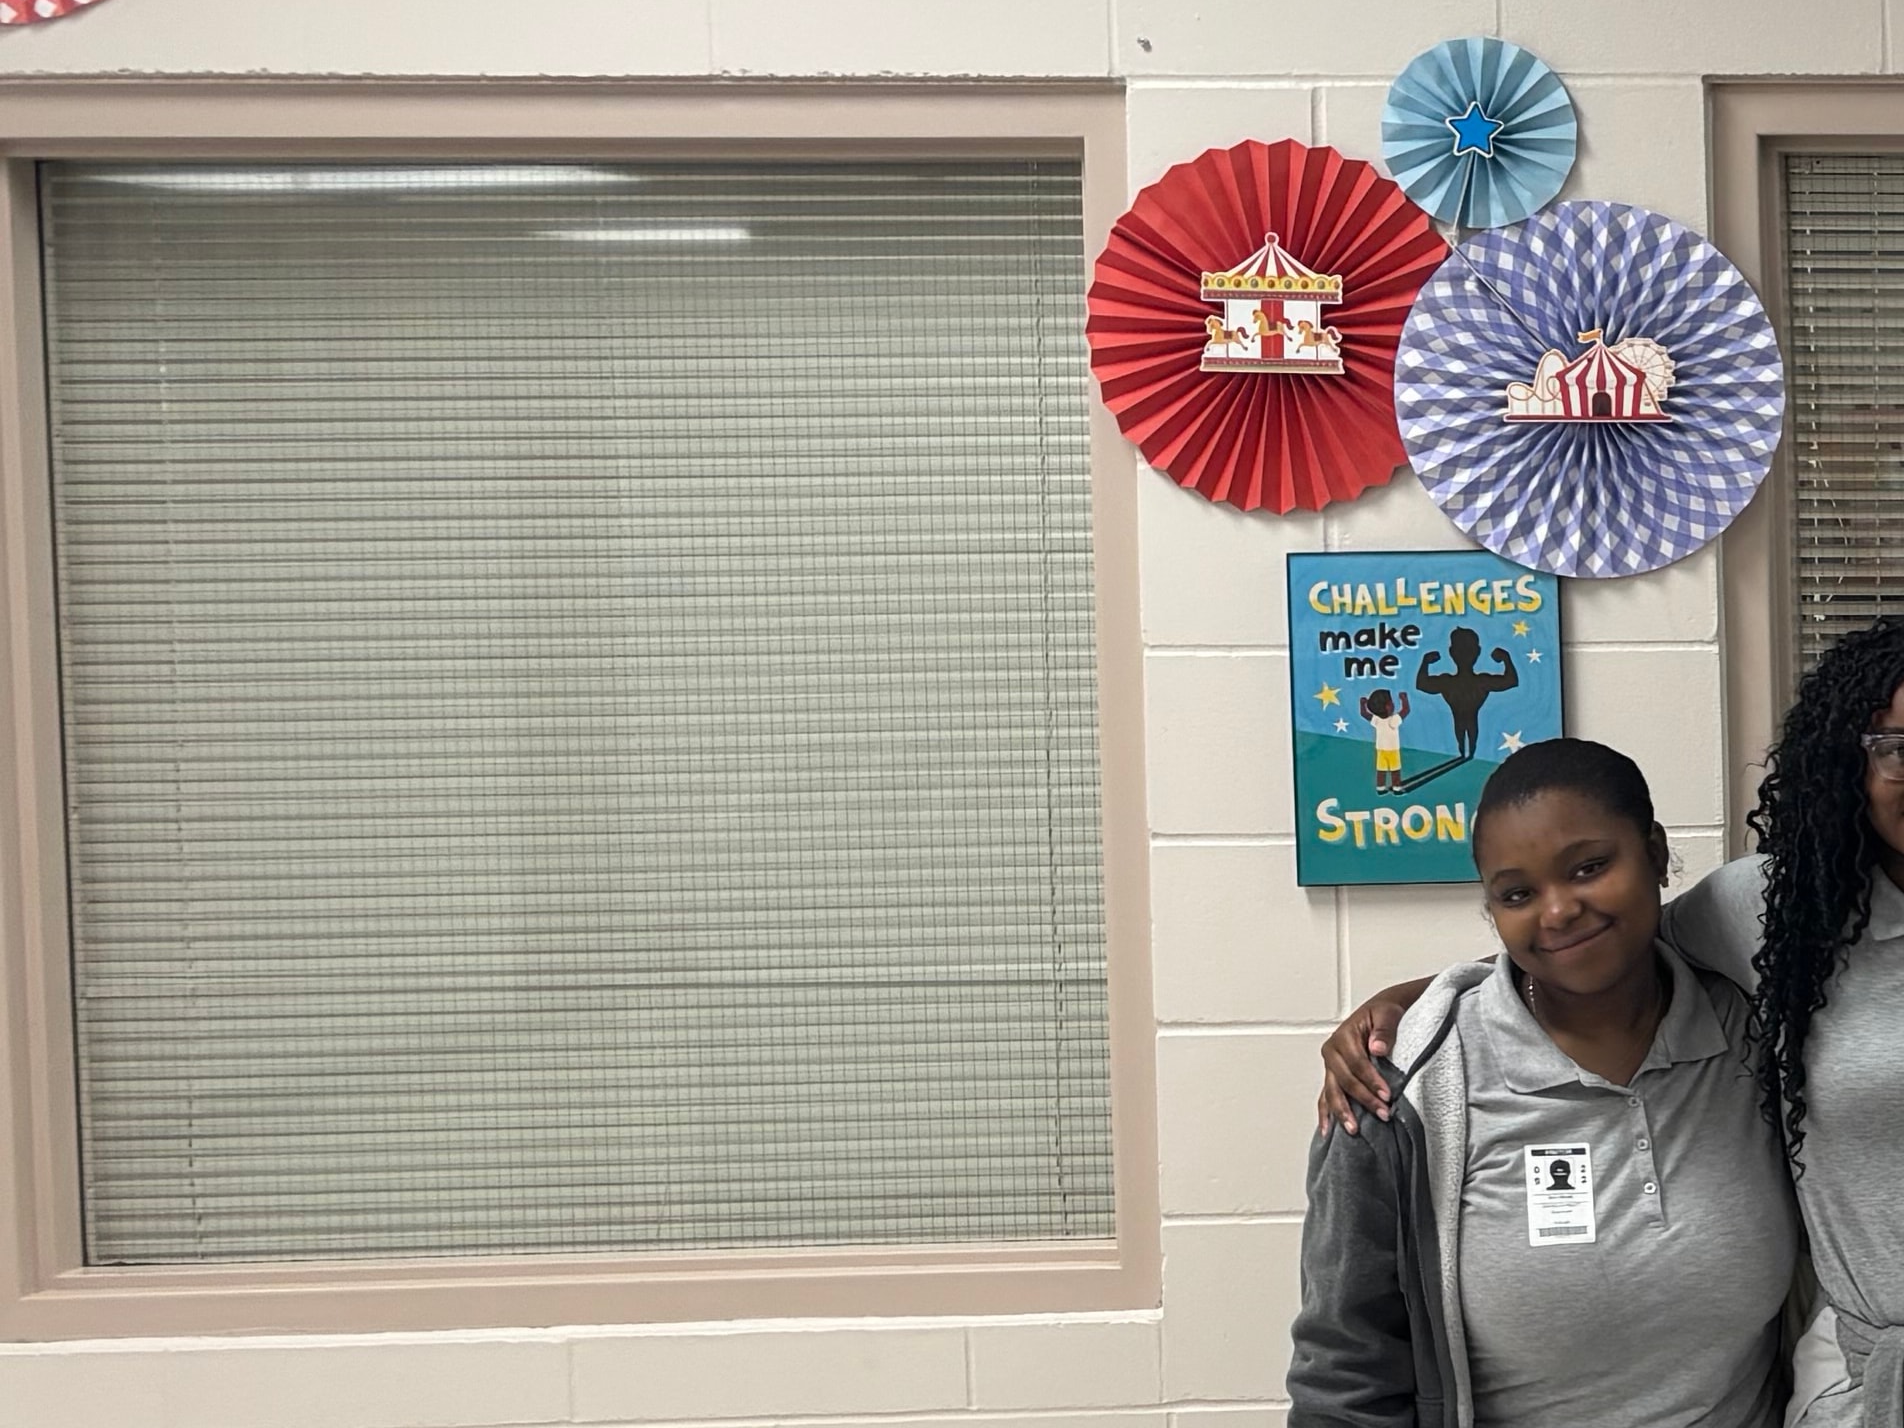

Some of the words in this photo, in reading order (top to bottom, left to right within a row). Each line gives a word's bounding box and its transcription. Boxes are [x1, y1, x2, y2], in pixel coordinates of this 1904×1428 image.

[1308, 575, 1543, 616] CHALLENGES
[1319, 623, 1422, 652] make
[1344, 653, 1401, 679] me
[1316, 798, 1477, 849] STRON
